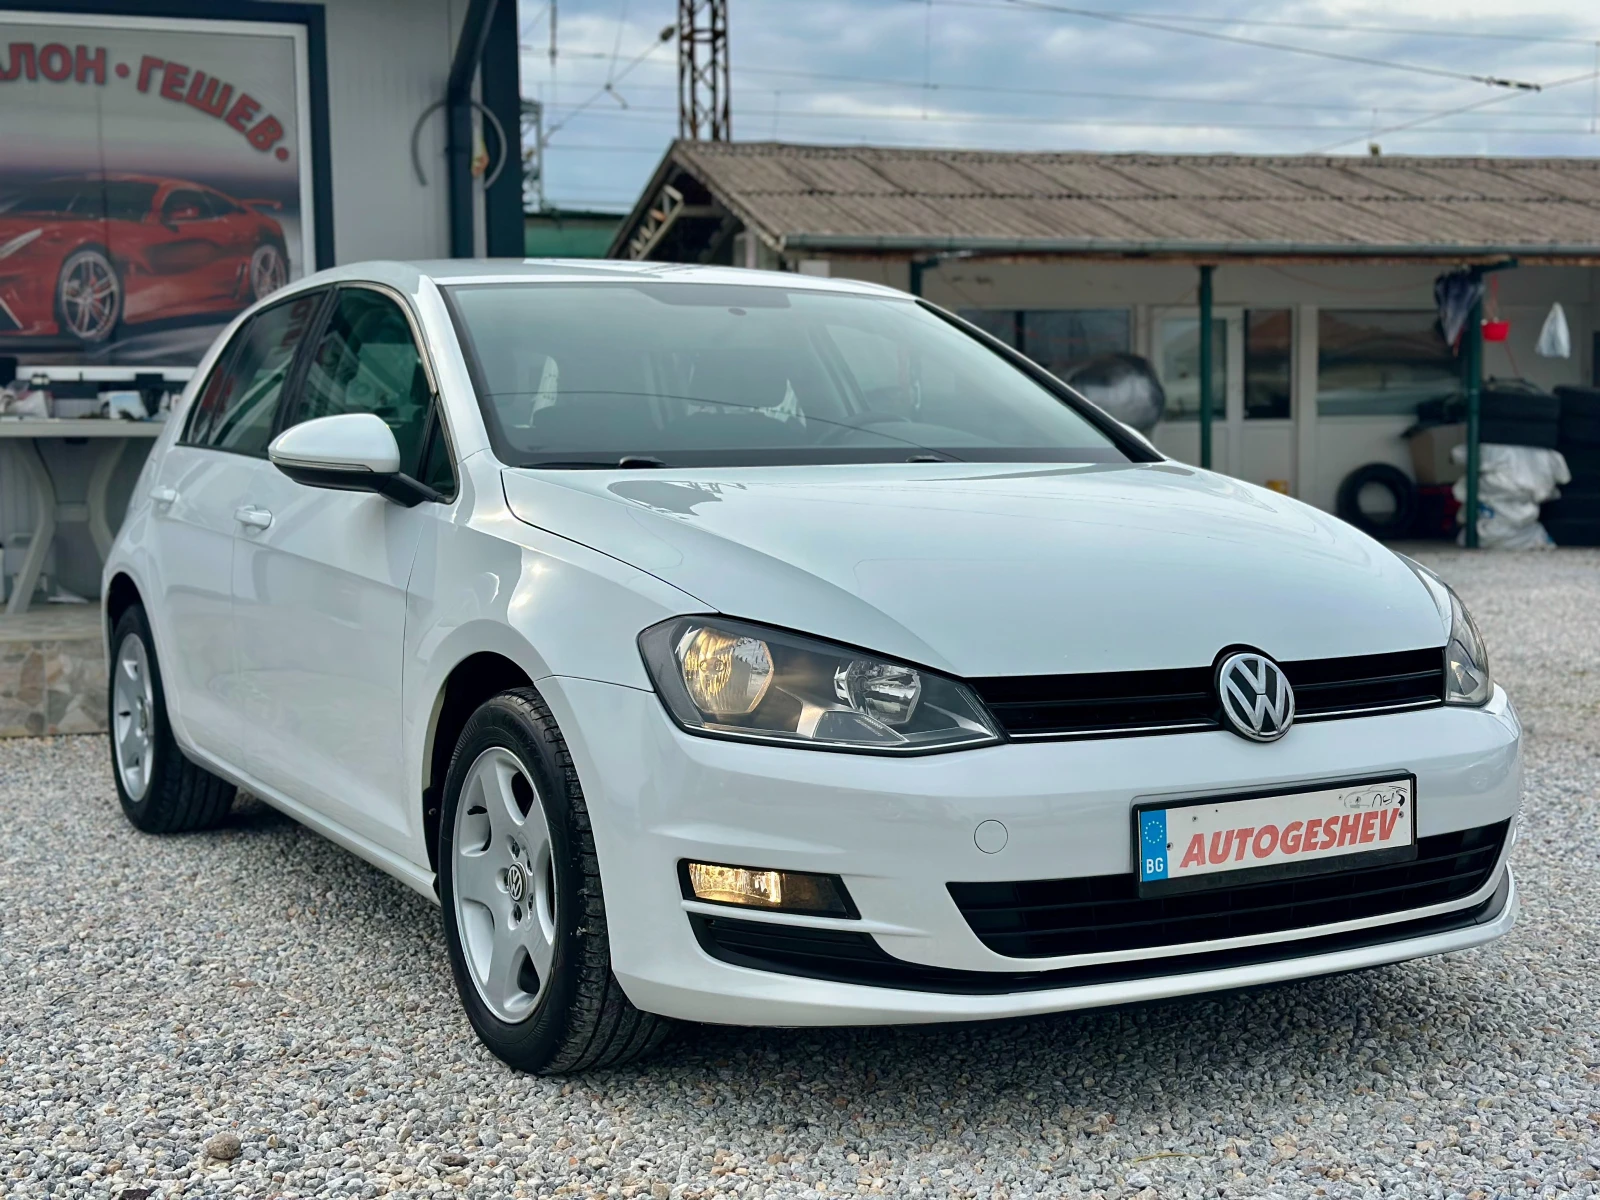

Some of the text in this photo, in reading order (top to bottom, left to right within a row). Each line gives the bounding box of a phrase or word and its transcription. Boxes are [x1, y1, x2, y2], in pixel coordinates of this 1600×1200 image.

[0, 42, 284, 152] ЛОН ГЕШЕВ
[1219, 652, 1295, 742] VW
[1146, 857, 1164, 874] BG
[1179, 807, 1400, 869] AUTOGESHEV
